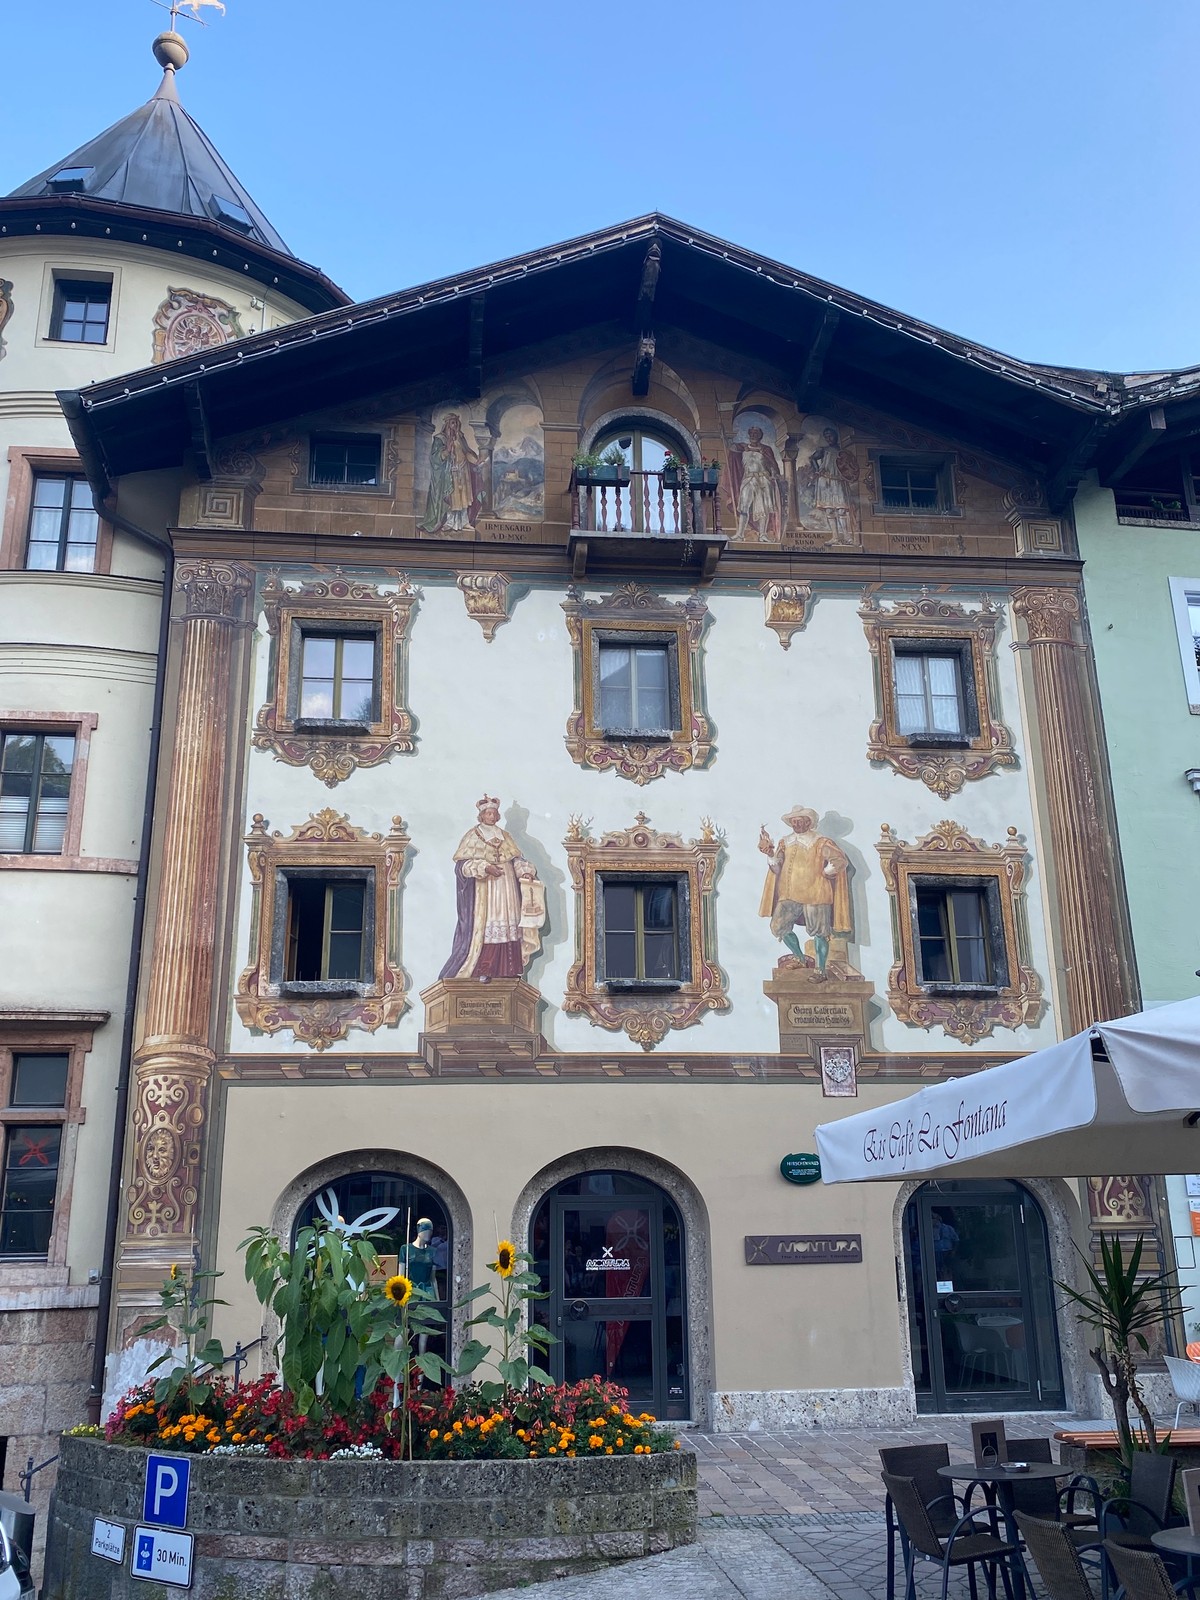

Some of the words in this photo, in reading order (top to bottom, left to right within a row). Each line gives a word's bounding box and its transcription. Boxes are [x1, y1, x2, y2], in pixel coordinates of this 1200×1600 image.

[485, 524, 532, 532] IRMENGARD
[794, 1006, 812, 1014] Georg
[863, 1128, 886, 1163] Eis
[917, 1112, 940, 1153] La
[943, 1100, 1008, 1160] Fontana
[777, 1239, 860, 1253] MONTURA
[586, 1259, 630, 1267] MONTURA
[154, 1465, 179, 1515] P
[106, 1530, 110, 1538] 2
[95, 1538, 120, 1554] Parkplätze
[156, 1549, 167, 1563] 30
[168, 1551, 187, 1566] Min.
